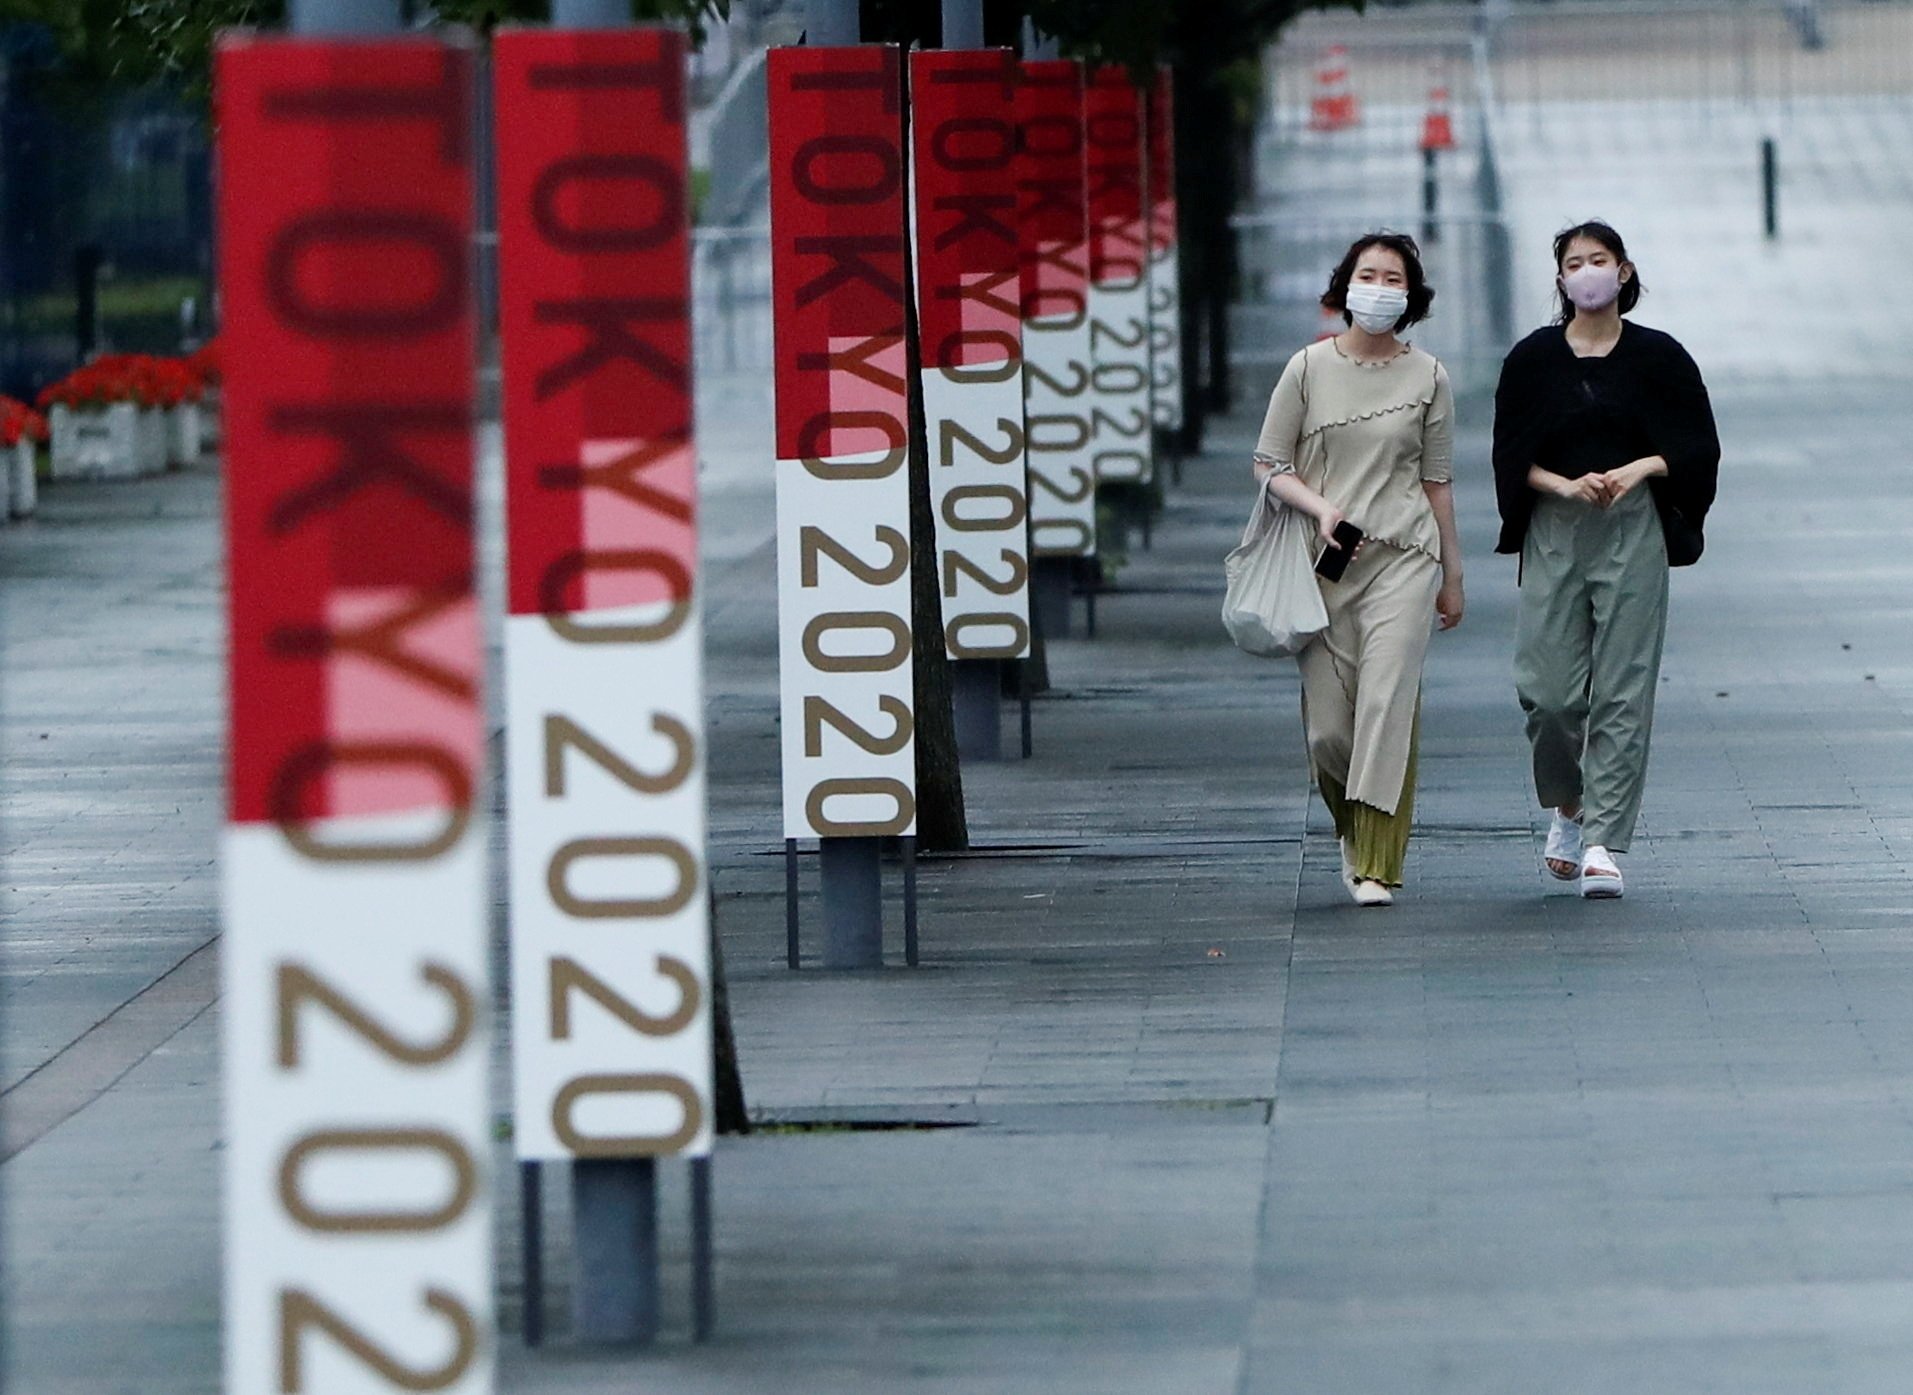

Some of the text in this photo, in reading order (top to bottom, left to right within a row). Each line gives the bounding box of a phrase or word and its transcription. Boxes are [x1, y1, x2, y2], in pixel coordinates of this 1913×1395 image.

[264, 46, 475, 866] TOKYO
[526, 31, 704, 1158] TOKYO 2020
[789, 47, 916, 837] TOKYO 2020
[930, 50, 1029, 659] TOKYO 2020
[1023, 360, 1091, 556] 2020
[1090, 318, 1147, 481] 2020
